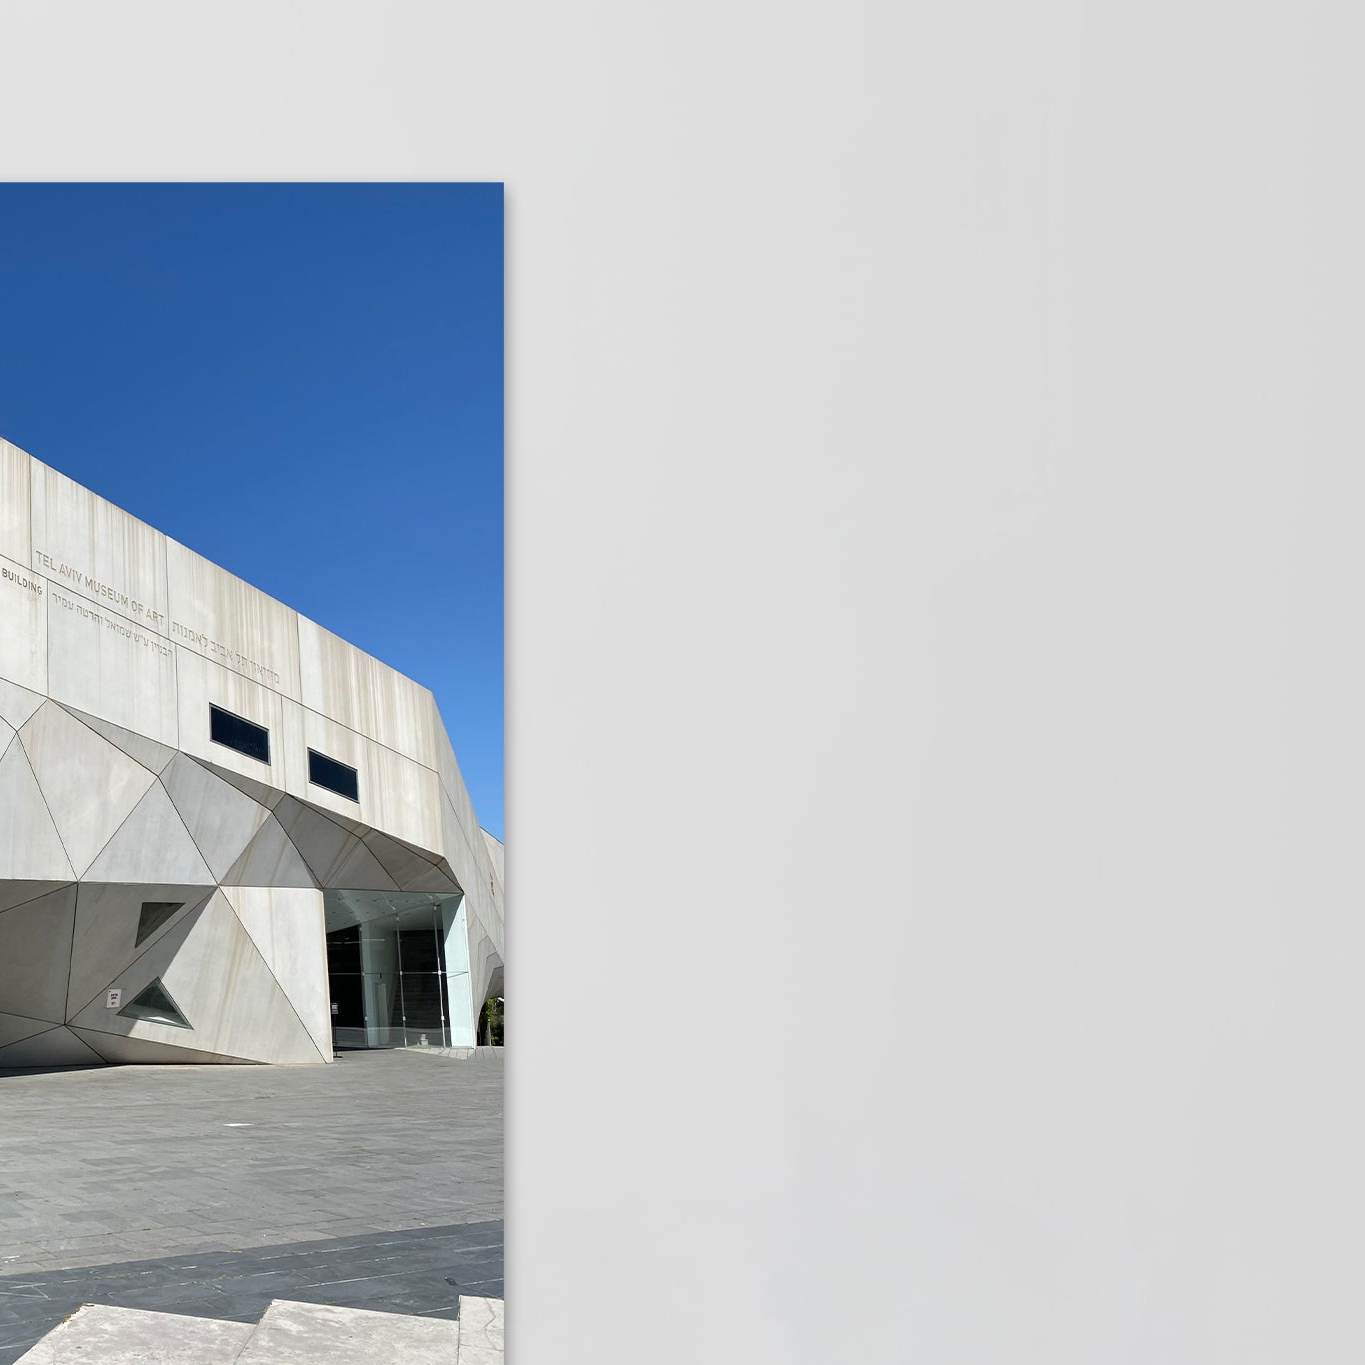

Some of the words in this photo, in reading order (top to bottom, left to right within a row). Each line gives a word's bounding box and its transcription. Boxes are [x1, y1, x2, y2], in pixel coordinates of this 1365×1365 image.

[1, 567, 43, 595] BUILDING
[36, 550, 57, 571] TEL
[59, 563, 83, 583] AVIV
[85, 576, 129, 608] MUSEUM
[131, 600, 144, 615] OF
[146, 608, 164, 627] ART
[52, 592, 74, 611] עמיר
[172, 621, 208, 648] לאמנות
[210, 640, 233, 662] אביב
